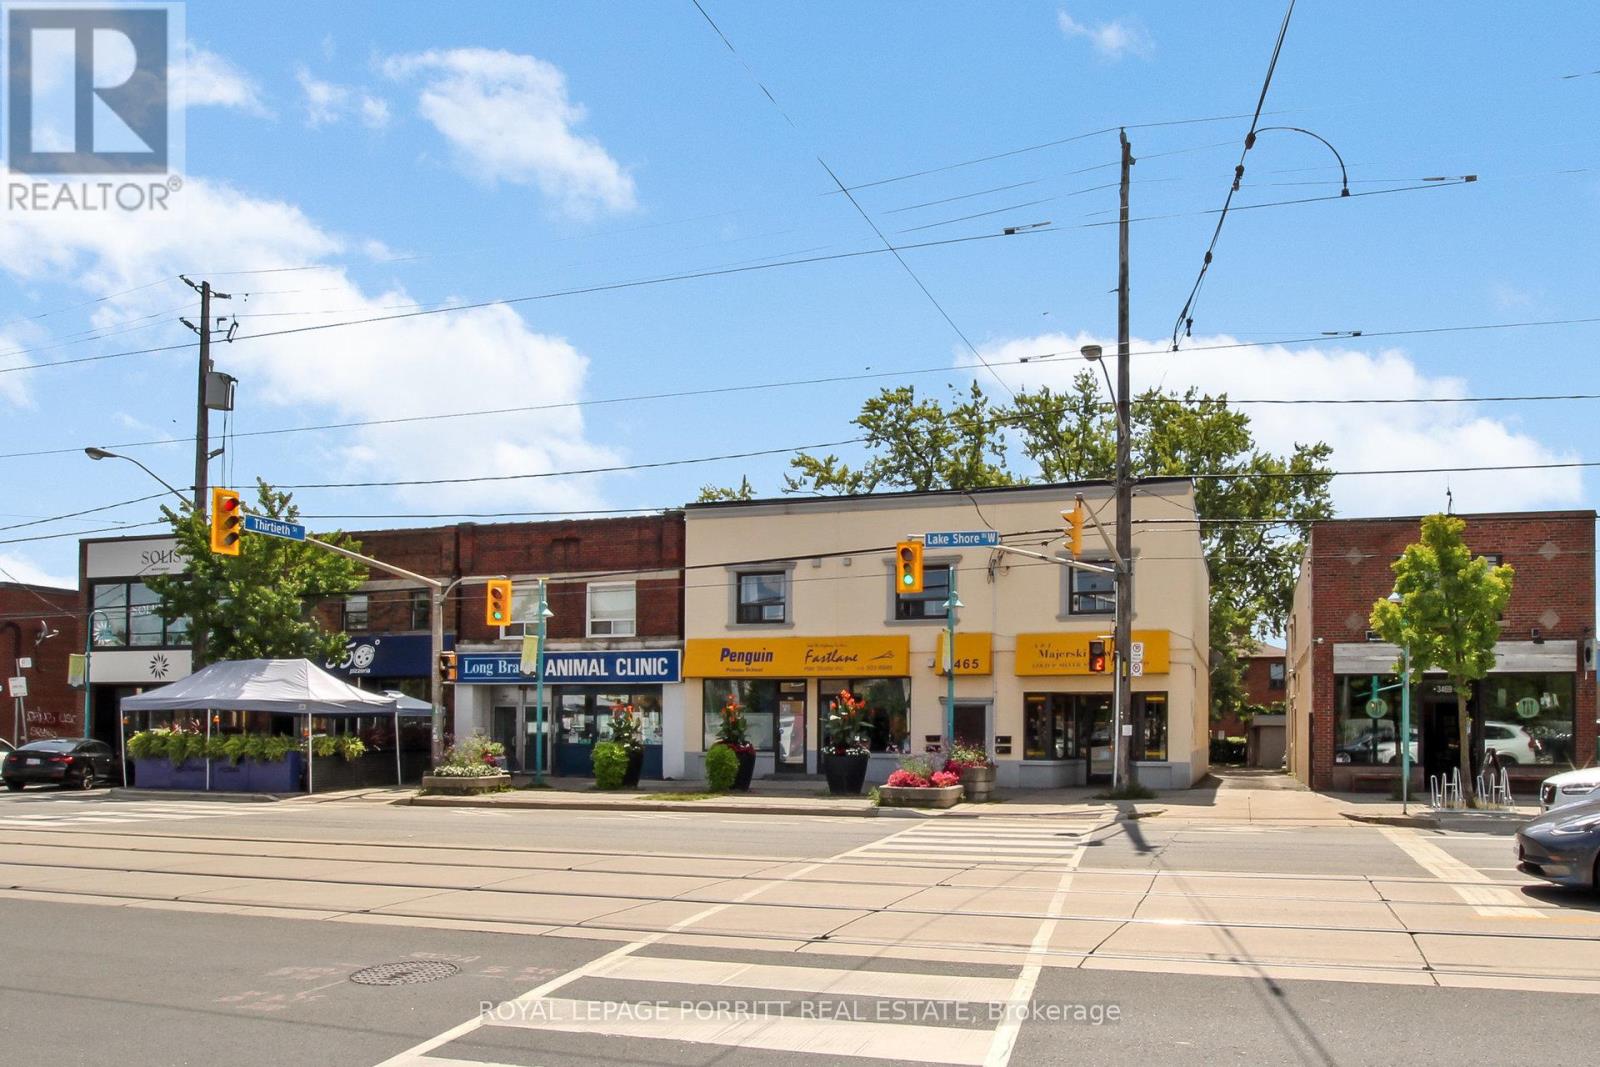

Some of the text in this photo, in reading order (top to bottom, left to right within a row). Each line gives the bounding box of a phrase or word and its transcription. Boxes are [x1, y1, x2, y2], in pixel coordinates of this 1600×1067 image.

[254, 518, 290, 535] Thirtieth
[927, 534, 949, 544] Lake
[953, 533, 980, 544] Shore
[987, 532, 996, 543] W
[141, 549, 181, 564] SOLIS
[720, 647, 773, 666] Penguin
[804, 648, 858, 664] Fastlane
[1039, 649, 1087, 659] Majerski
[463, 659, 493, 676] Long
[545, 657, 668, 677] ANIMAL CLINIC
